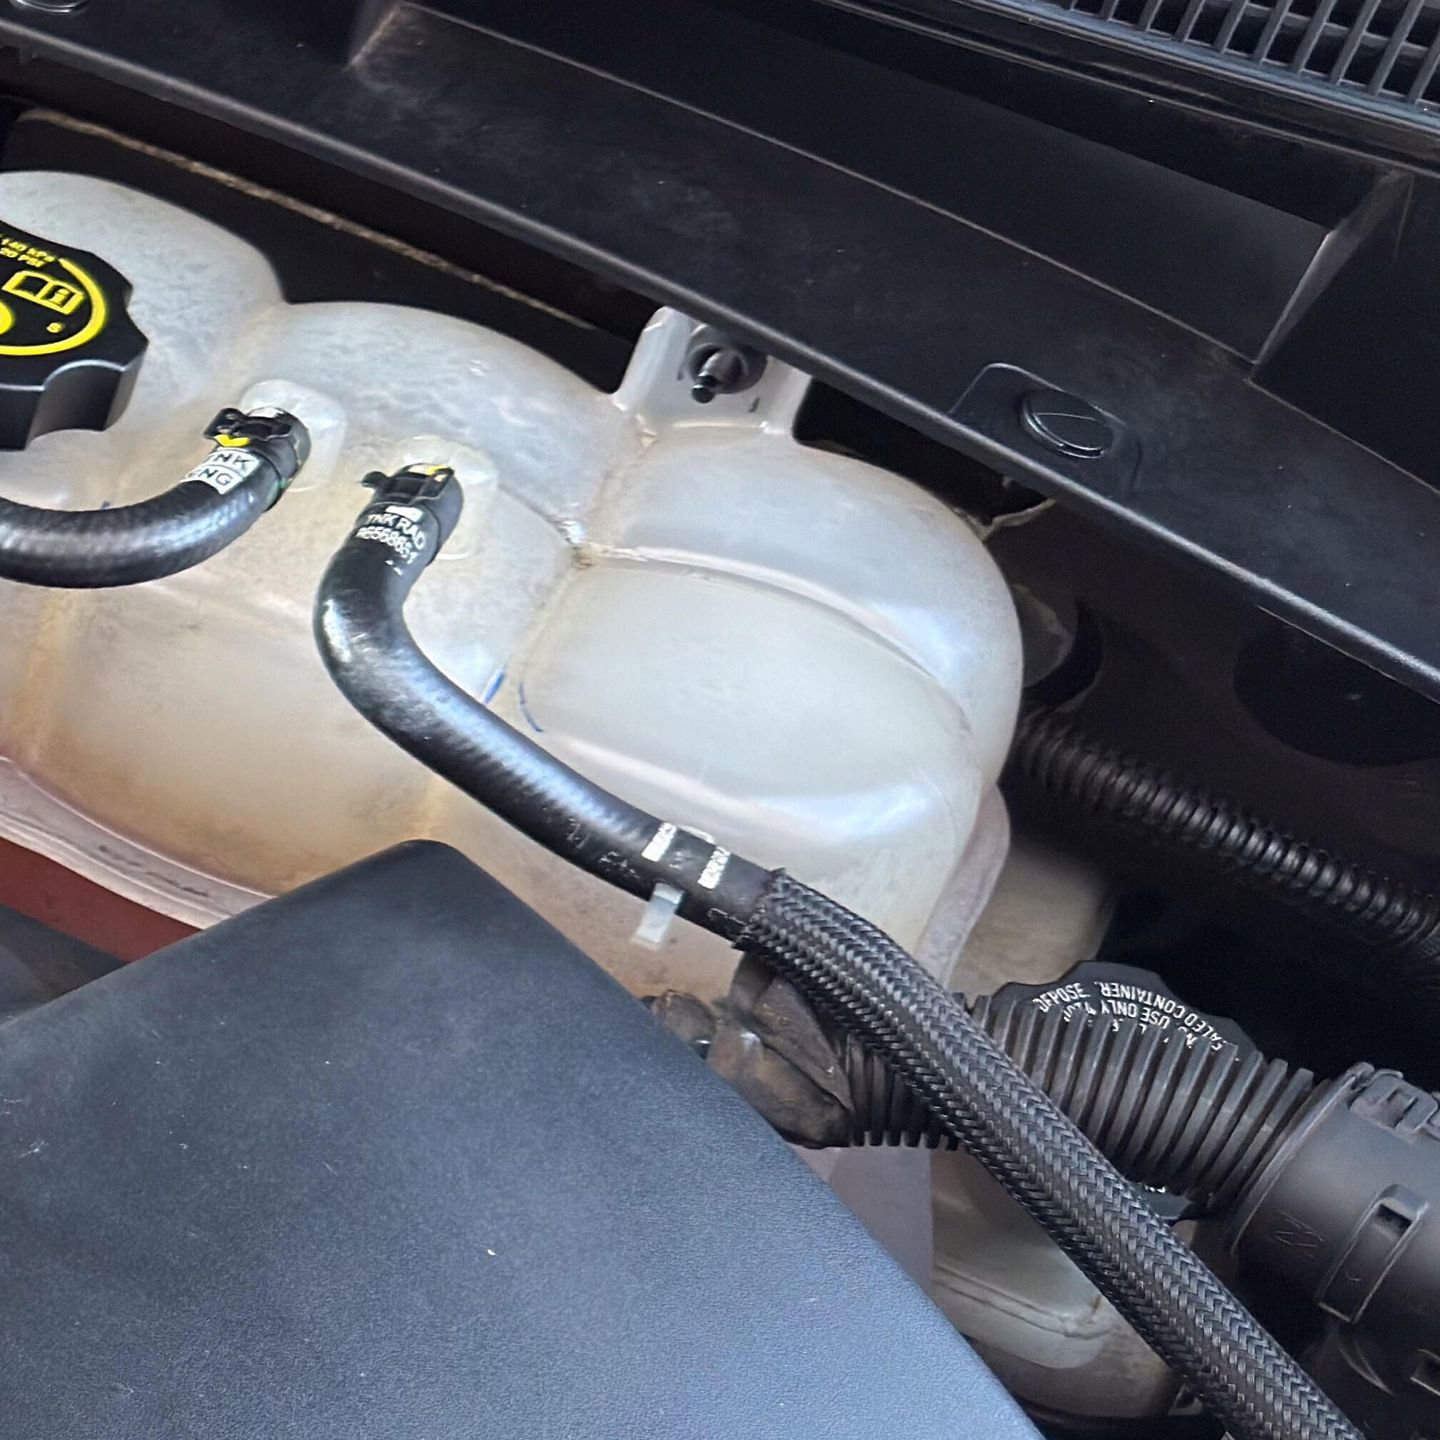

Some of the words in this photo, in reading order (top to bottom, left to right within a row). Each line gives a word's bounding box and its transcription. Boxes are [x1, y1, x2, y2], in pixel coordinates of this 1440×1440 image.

[17, 254, 45, 268] PSI
[396, 517, 426, 550] RAD
[1101, 999, 1137, 1018] ONLY
[1140, 1007, 1171, 1029] USE
